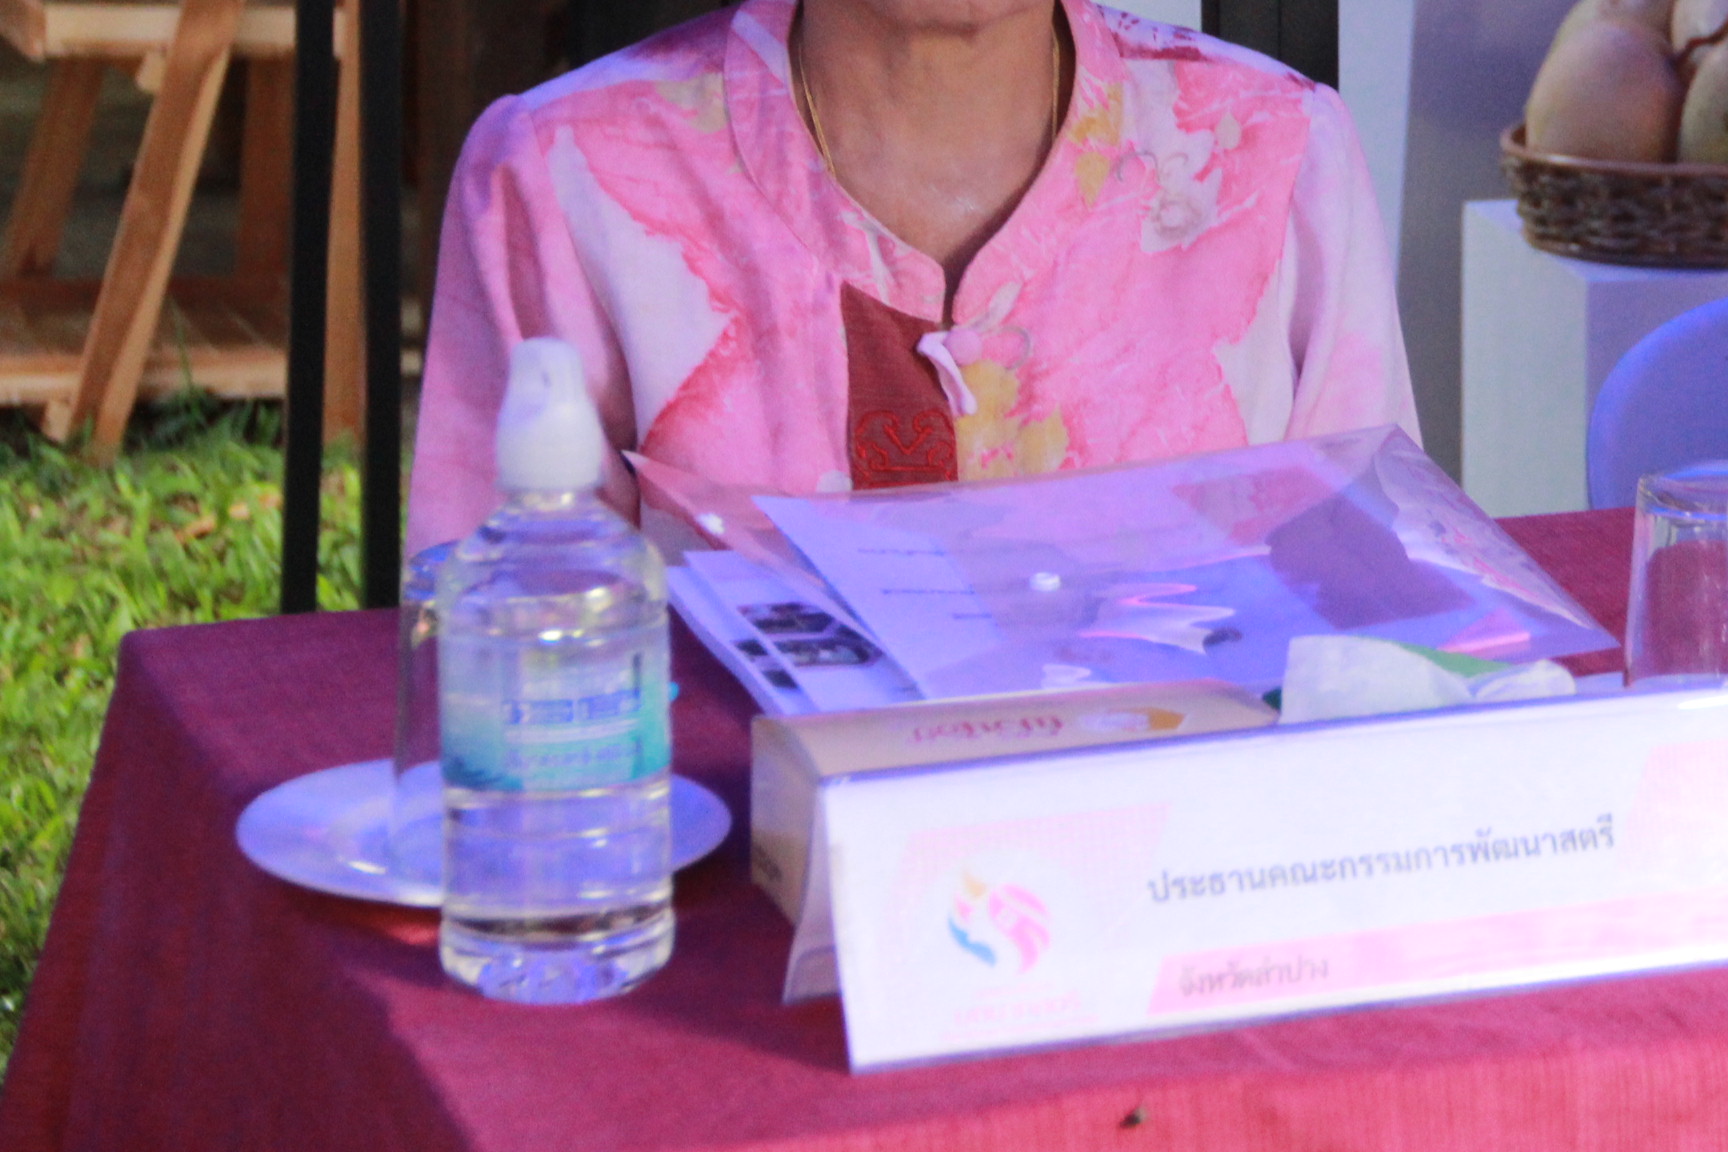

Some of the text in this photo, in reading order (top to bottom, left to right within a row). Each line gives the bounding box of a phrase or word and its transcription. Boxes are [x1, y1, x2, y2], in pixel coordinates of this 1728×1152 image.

[1148, 813, 1616, 904] ประธานคณะกรรมการพัฒนาสตรี
